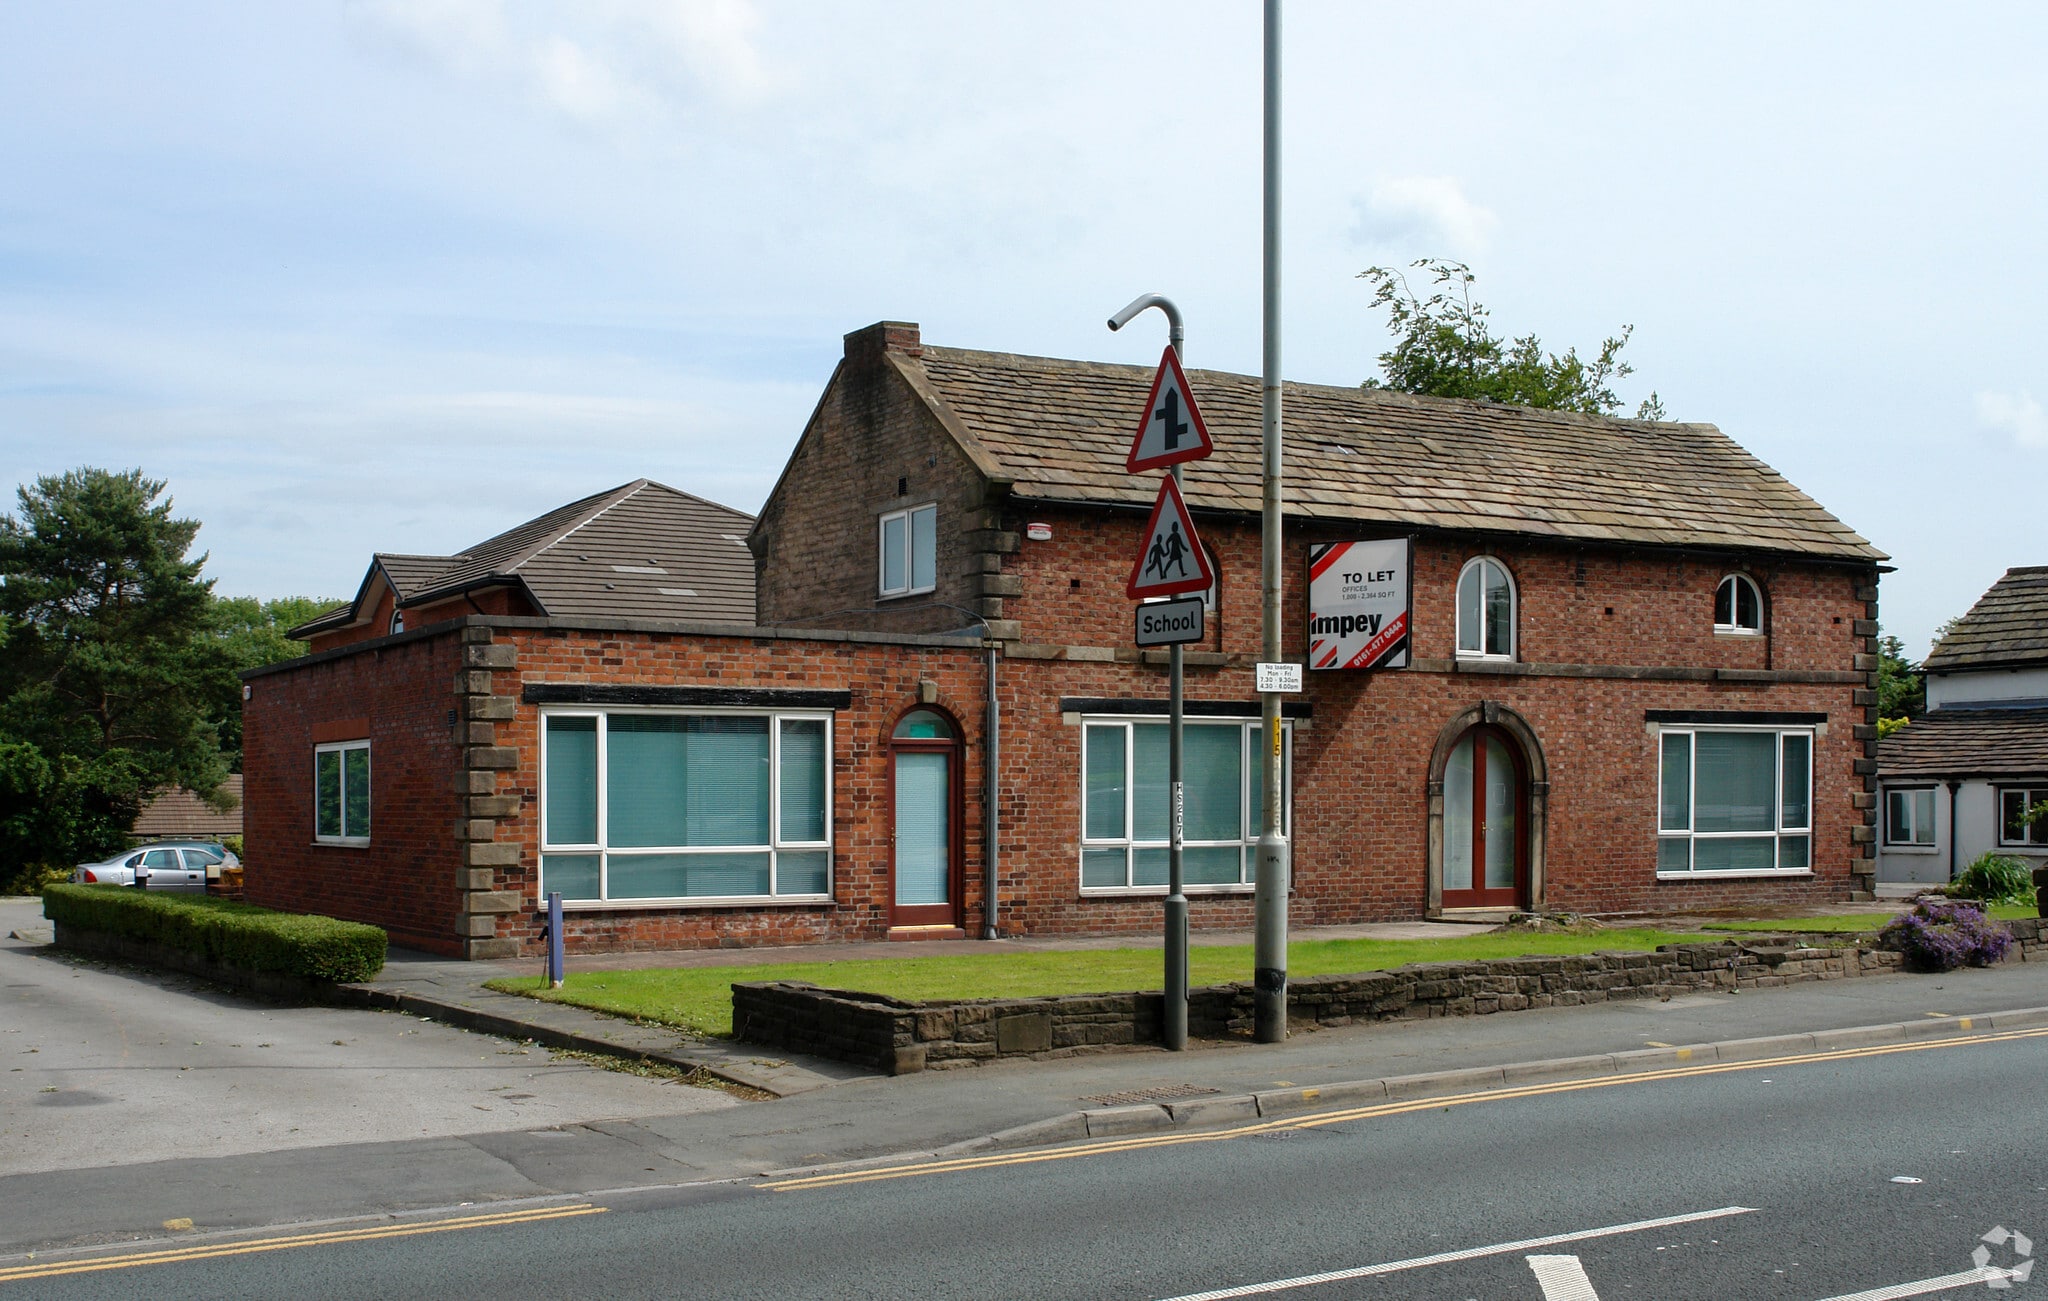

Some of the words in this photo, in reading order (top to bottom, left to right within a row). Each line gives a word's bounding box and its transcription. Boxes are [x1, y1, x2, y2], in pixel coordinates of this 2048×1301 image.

[1342, 572, 1363, 584] TO
[1368, 570, 1395, 583] LET
[1342, 585, 1368, 593] OFFICES
[1378, 591, 1387, 599] SQ
[1143, 611, 1196, 634] School
[1311, 612, 1382, 638] impey
